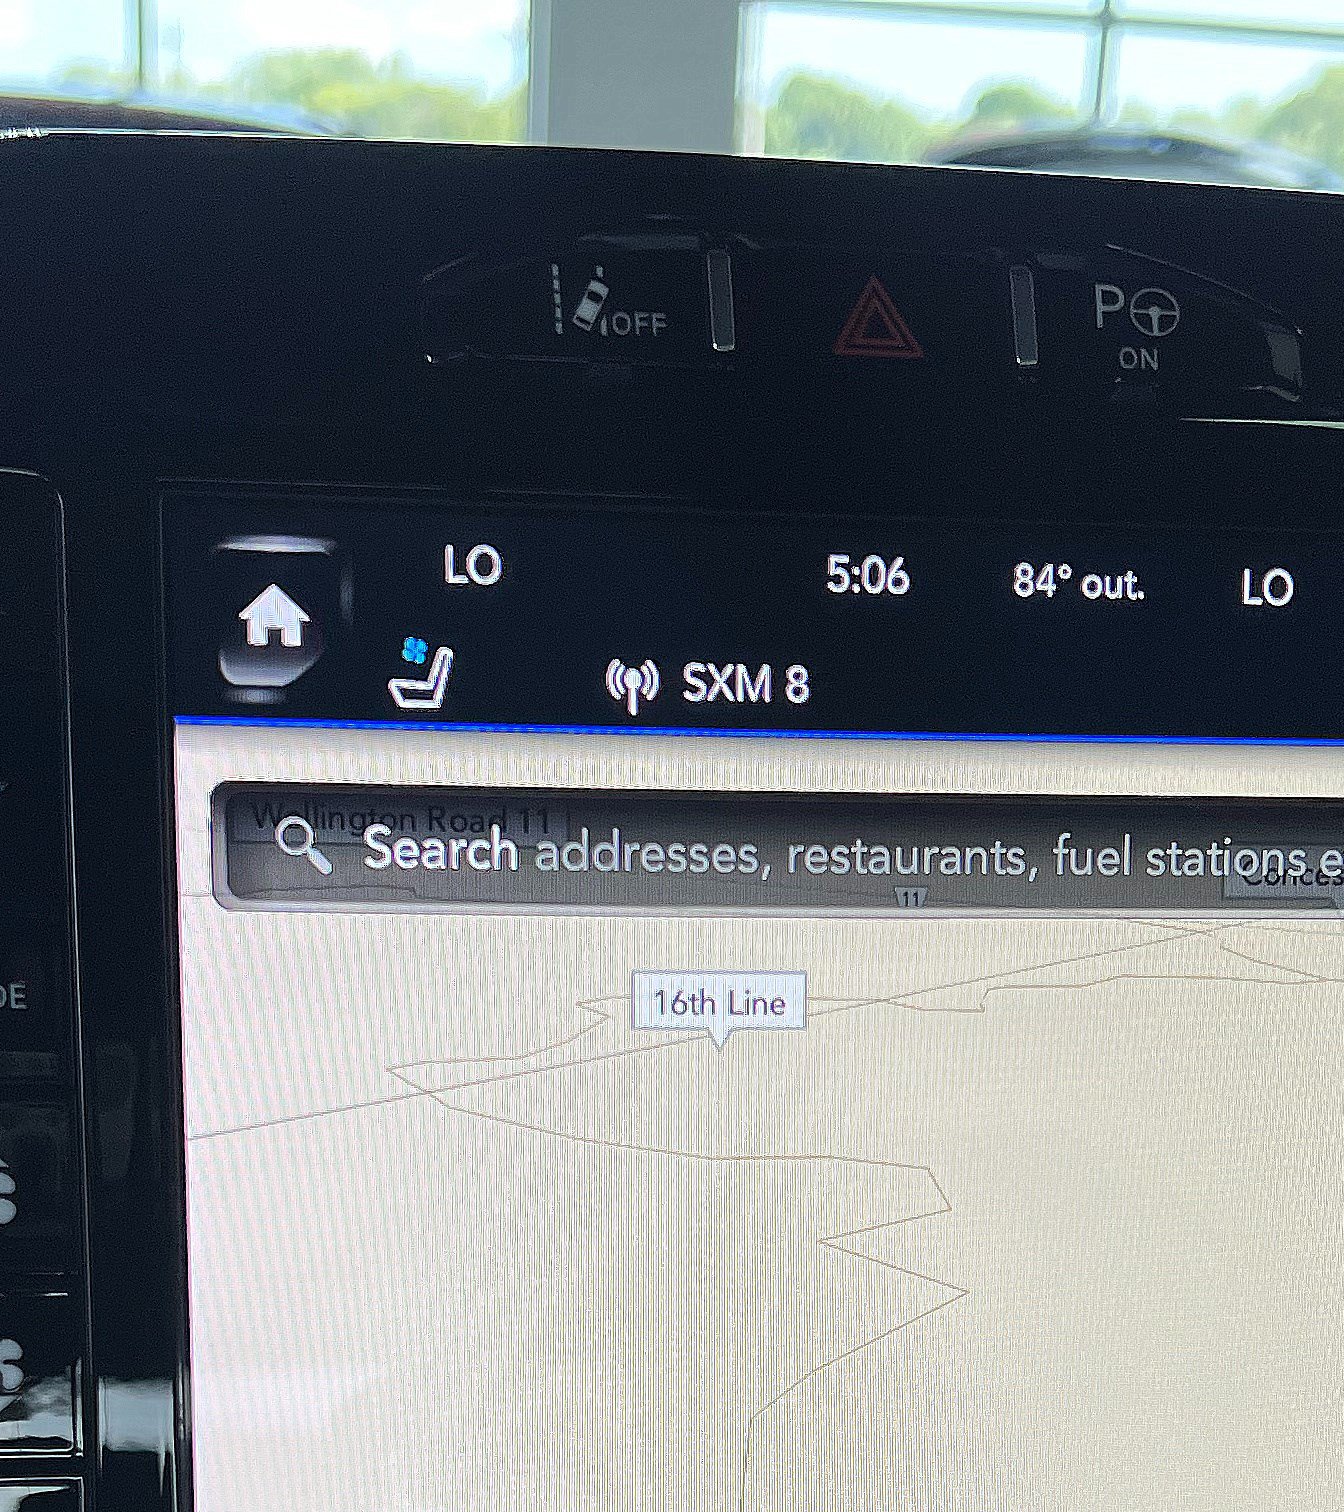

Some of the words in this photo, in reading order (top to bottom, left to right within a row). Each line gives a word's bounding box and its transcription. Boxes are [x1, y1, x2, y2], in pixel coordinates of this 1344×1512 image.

[612, 311, 668, 336] OFF
[1095, 284, 1126, 330] P
[1119, 347, 1159, 372] ON
[443, 543, 504, 586] LO
[825, 554, 911, 597] 5:06
[1012, 562, 1073, 598] 84°
[1081, 566, 1145, 602] out.
[1242, 567, 1294, 607] LO
[682, 663, 772, 703] SXM
[784, 665, 812, 704] 8
[363, 823, 520, 872] Search
[535, 828, 773, 881] addresses,
[787, 836, 1037, 882] restaurants,
[1053, 833, 1131, 876] fuel
[1145, 836, 1306, 878] stations
[901, 891, 921, 907] 11
[655, 988, 718, 1017] 16th
[727, 988, 787, 1017] Line
